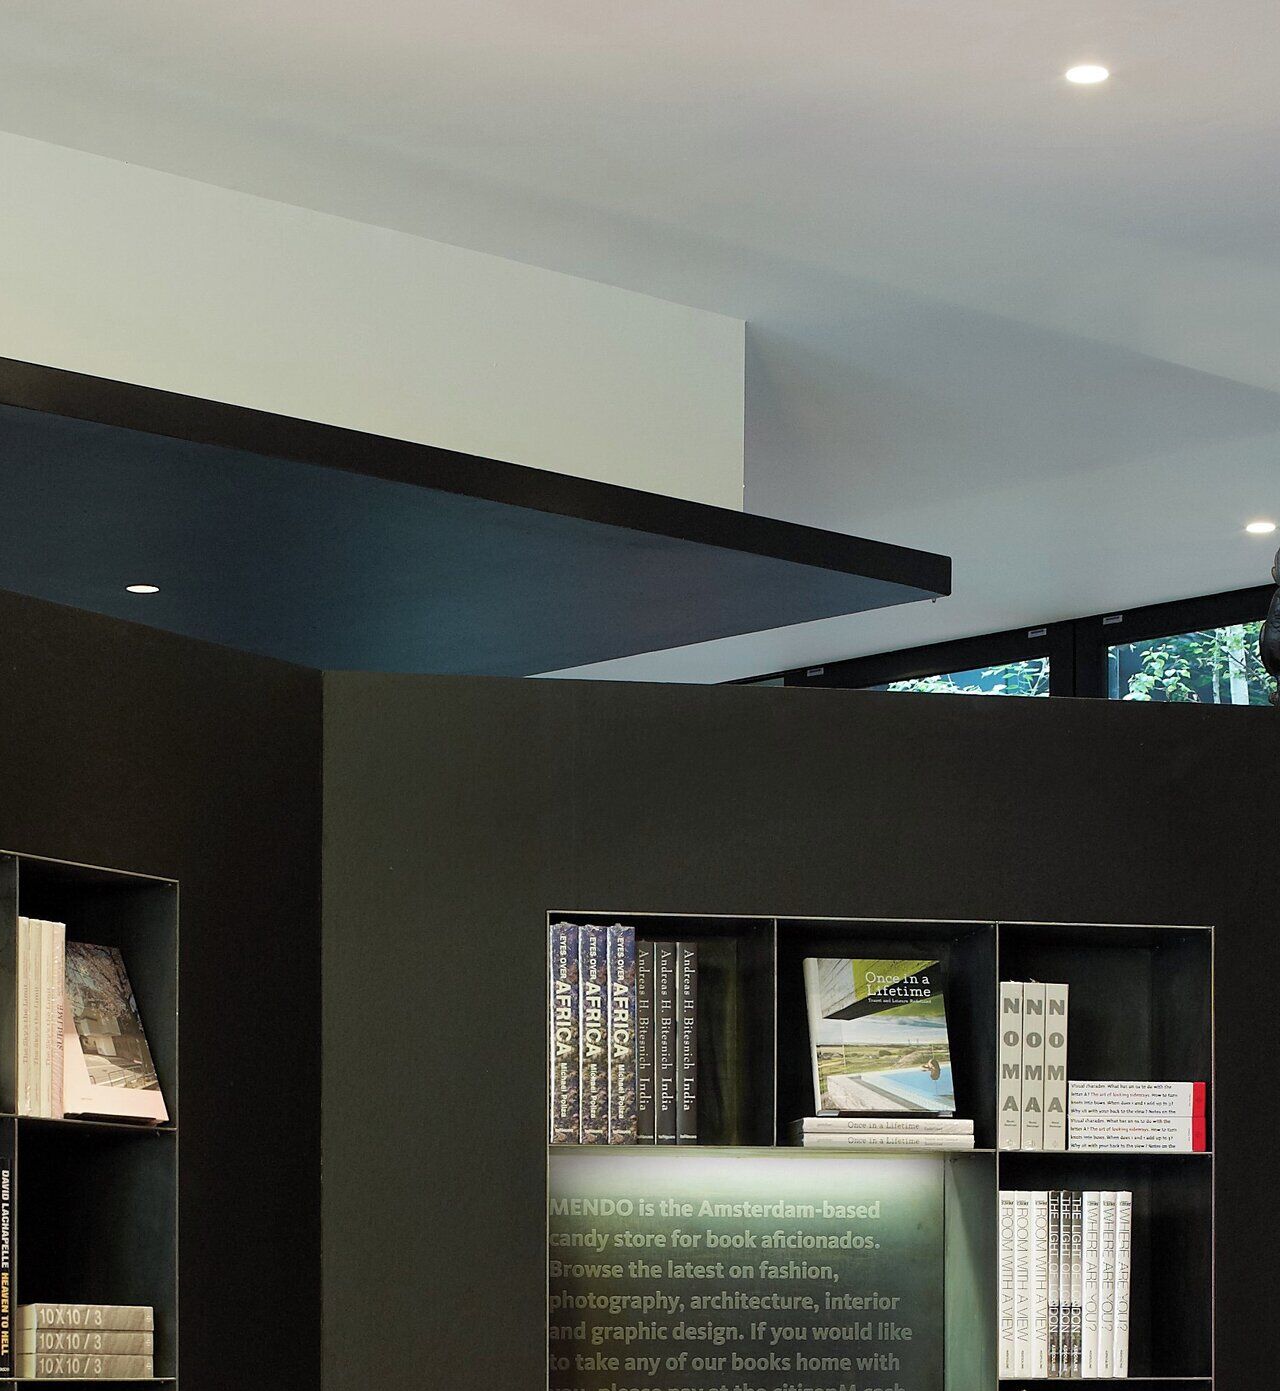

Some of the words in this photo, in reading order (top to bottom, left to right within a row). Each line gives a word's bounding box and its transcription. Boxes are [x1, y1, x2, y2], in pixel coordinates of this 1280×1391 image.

[684, 950, 695, 995] Andreas
[866, 972, 899, 983] Once
[903, 974, 917, 984] in
[921, 976, 929, 984] a
[867, 985, 931, 997] Lifetime
[556, 981, 571, 1055] AFRICA
[684, 1000, 694, 1013] H.
[586, 982, 601, 1056] AFRICA
[614, 983, 628, 1057] AFRICA
[684, 1018, 695, 1070] Bitesnich
[684, 1078, 695, 1110] India
[550, 1199, 633, 1216] MENDO
[639, 1200, 655, 1217] is
[660, 1199, 693, 1217] the
[698, 1200, 880, 1219] Amsterdam-based
[1, 1202, 9, 1268] LACHAPELLE
[550, 1230, 608, 1252] candy
[614, 1233, 666, 1249] store
[671, 1230, 701, 1249] for
[706, 1230, 756, 1250] book
[761, 1231, 880, 1250] aficionados.
[550, 1261, 623, 1279] Browse
[628, 1261, 662, 1279] the
[667, 1261, 724, 1279] latest
[729, 1264, 754, 1279] on
[759, 1261, 839, 1283] fashion,
[1, 1273, 9, 1313] HEAVEN
[550, 1292, 685, 1315] photography,
[690, 1292, 819, 1313] architecture,
[825, 1293, 899, 1310] interior
[1, 1315, 9, 1327] TO
[40, 1309, 80, 1324] 10X10
[94, 1310, 101, 1325] 3
[1, 1330, 9, 1355] HELL
[40, 1334, 80, 1349] 10X10
[94, 1335, 101, 1350] 3
[550, 1322, 586, 1340] and
[591, 1322, 667, 1345] graphic
[672, 1322, 744, 1345] design.
[751, 1322, 766, 1341] If
[770, 1326, 807, 1345] you
[812, 1322, 872, 1341] would
[877, 1322, 912, 1341] like
[40, 1359, 80, 1374] 10X10
[94, 1360, 101, 1375] 3
[550, 1355, 570, 1371] to
[575, 1353, 619, 1371] take
[624, 1356, 660, 1376] any
[665, 1353, 687, 1371] of
[691, 1356, 726, 1371] our
[731, 1353, 791, 1371] books
[796, 1353, 851, 1371] home
[856, 1353, 899, 1371] with
